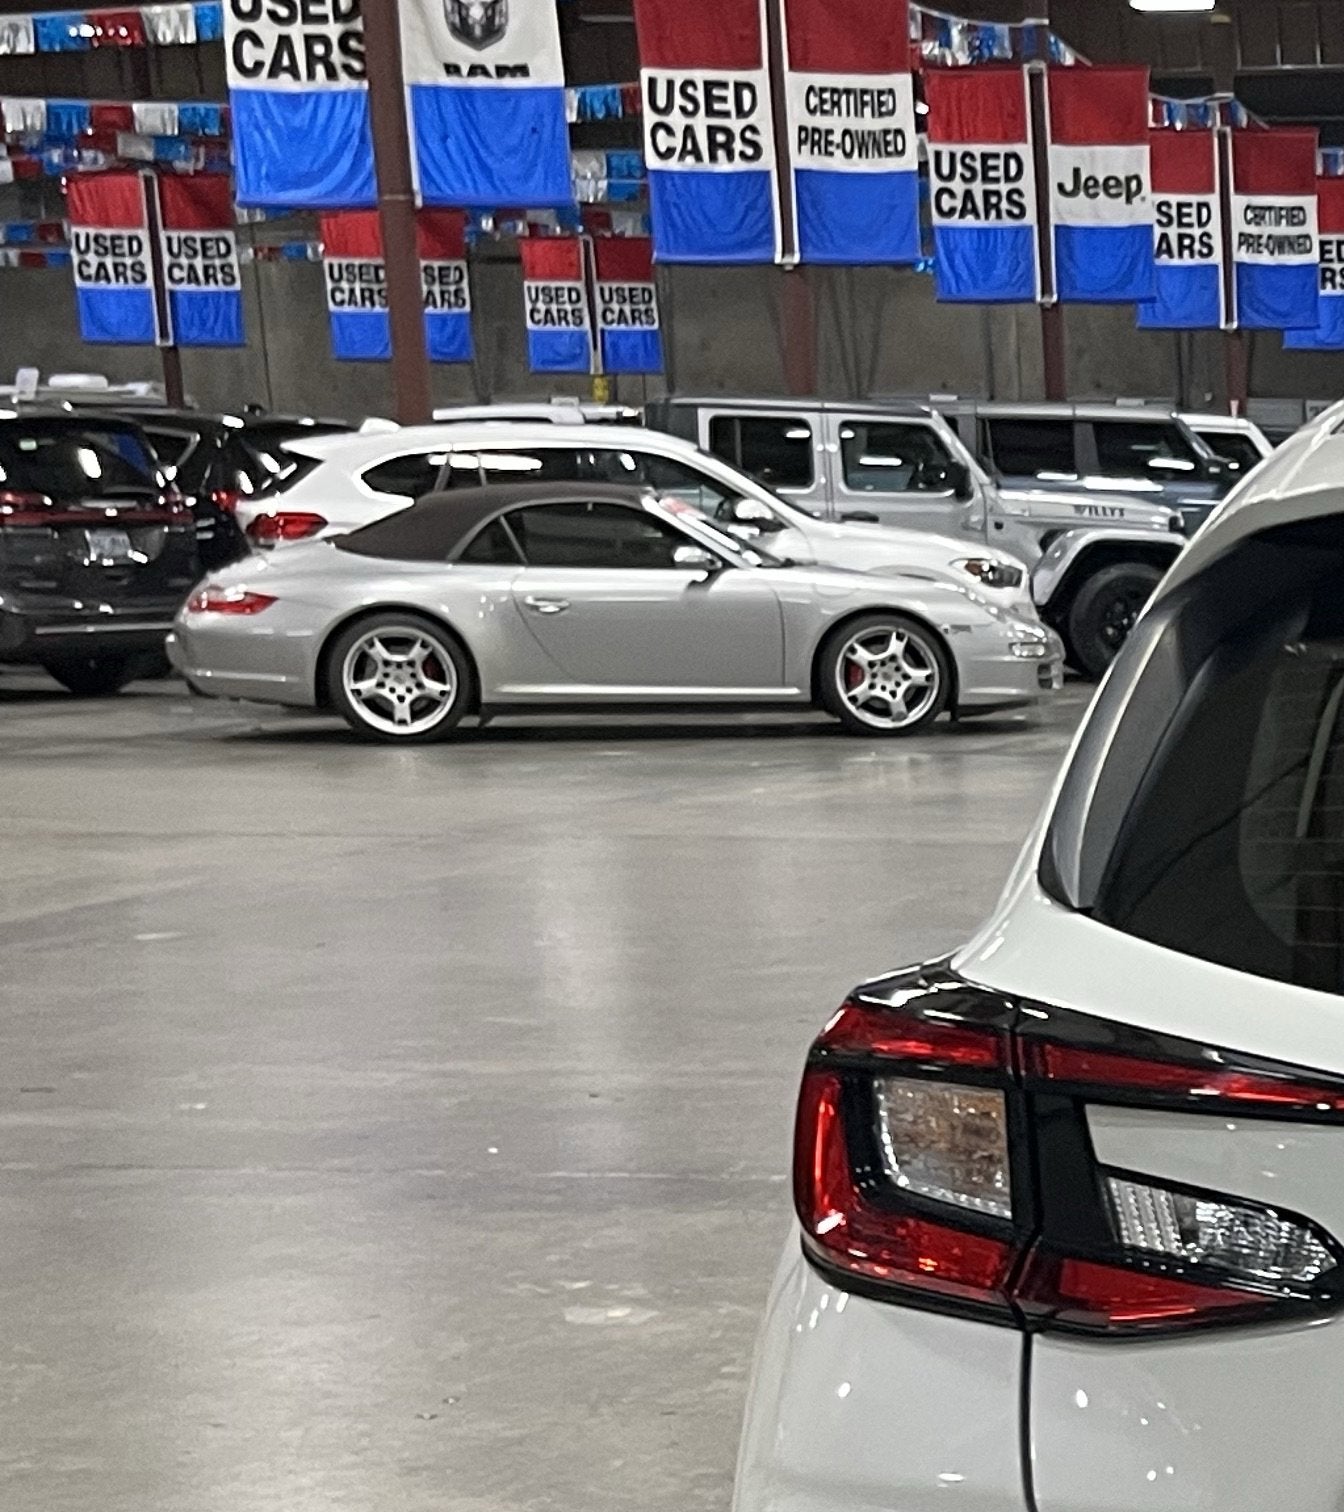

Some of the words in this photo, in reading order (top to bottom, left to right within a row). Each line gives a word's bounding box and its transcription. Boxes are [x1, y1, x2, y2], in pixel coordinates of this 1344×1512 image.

[232, 29, 367, 81] CARS
[443, 63, 530, 78] RAM
[648, 76, 758, 119] USED
[805, 84, 896, 119] CERTIFIED
[650, 121, 763, 163] CARS
[798, 125, 906, 159] PRE-OWNED
[934, 150, 1024, 184] USED
[1057, 166, 1144, 205] Jeep
[934, 187, 1027, 220] CARS
[1155, 200, 1212, 228] SED
[1244, 204, 1307, 227] CERTIFIED
[74, 232, 143, 257] USED
[166, 235, 232, 259] USED
[1155, 231, 1214, 259] ARS
[1237, 232, 1313, 256] PRE-OWNED
[78, 259, 147, 284] CARS
[167, 262, 236, 286] CARS
[424, 265, 464, 286] SED
[424, 288, 467, 309] ARS
[527, 286, 581, 305] USED
[600, 286, 653, 305] USED
[529, 307, 584, 327] CARS
[601, 307, 656, 326] CARS
